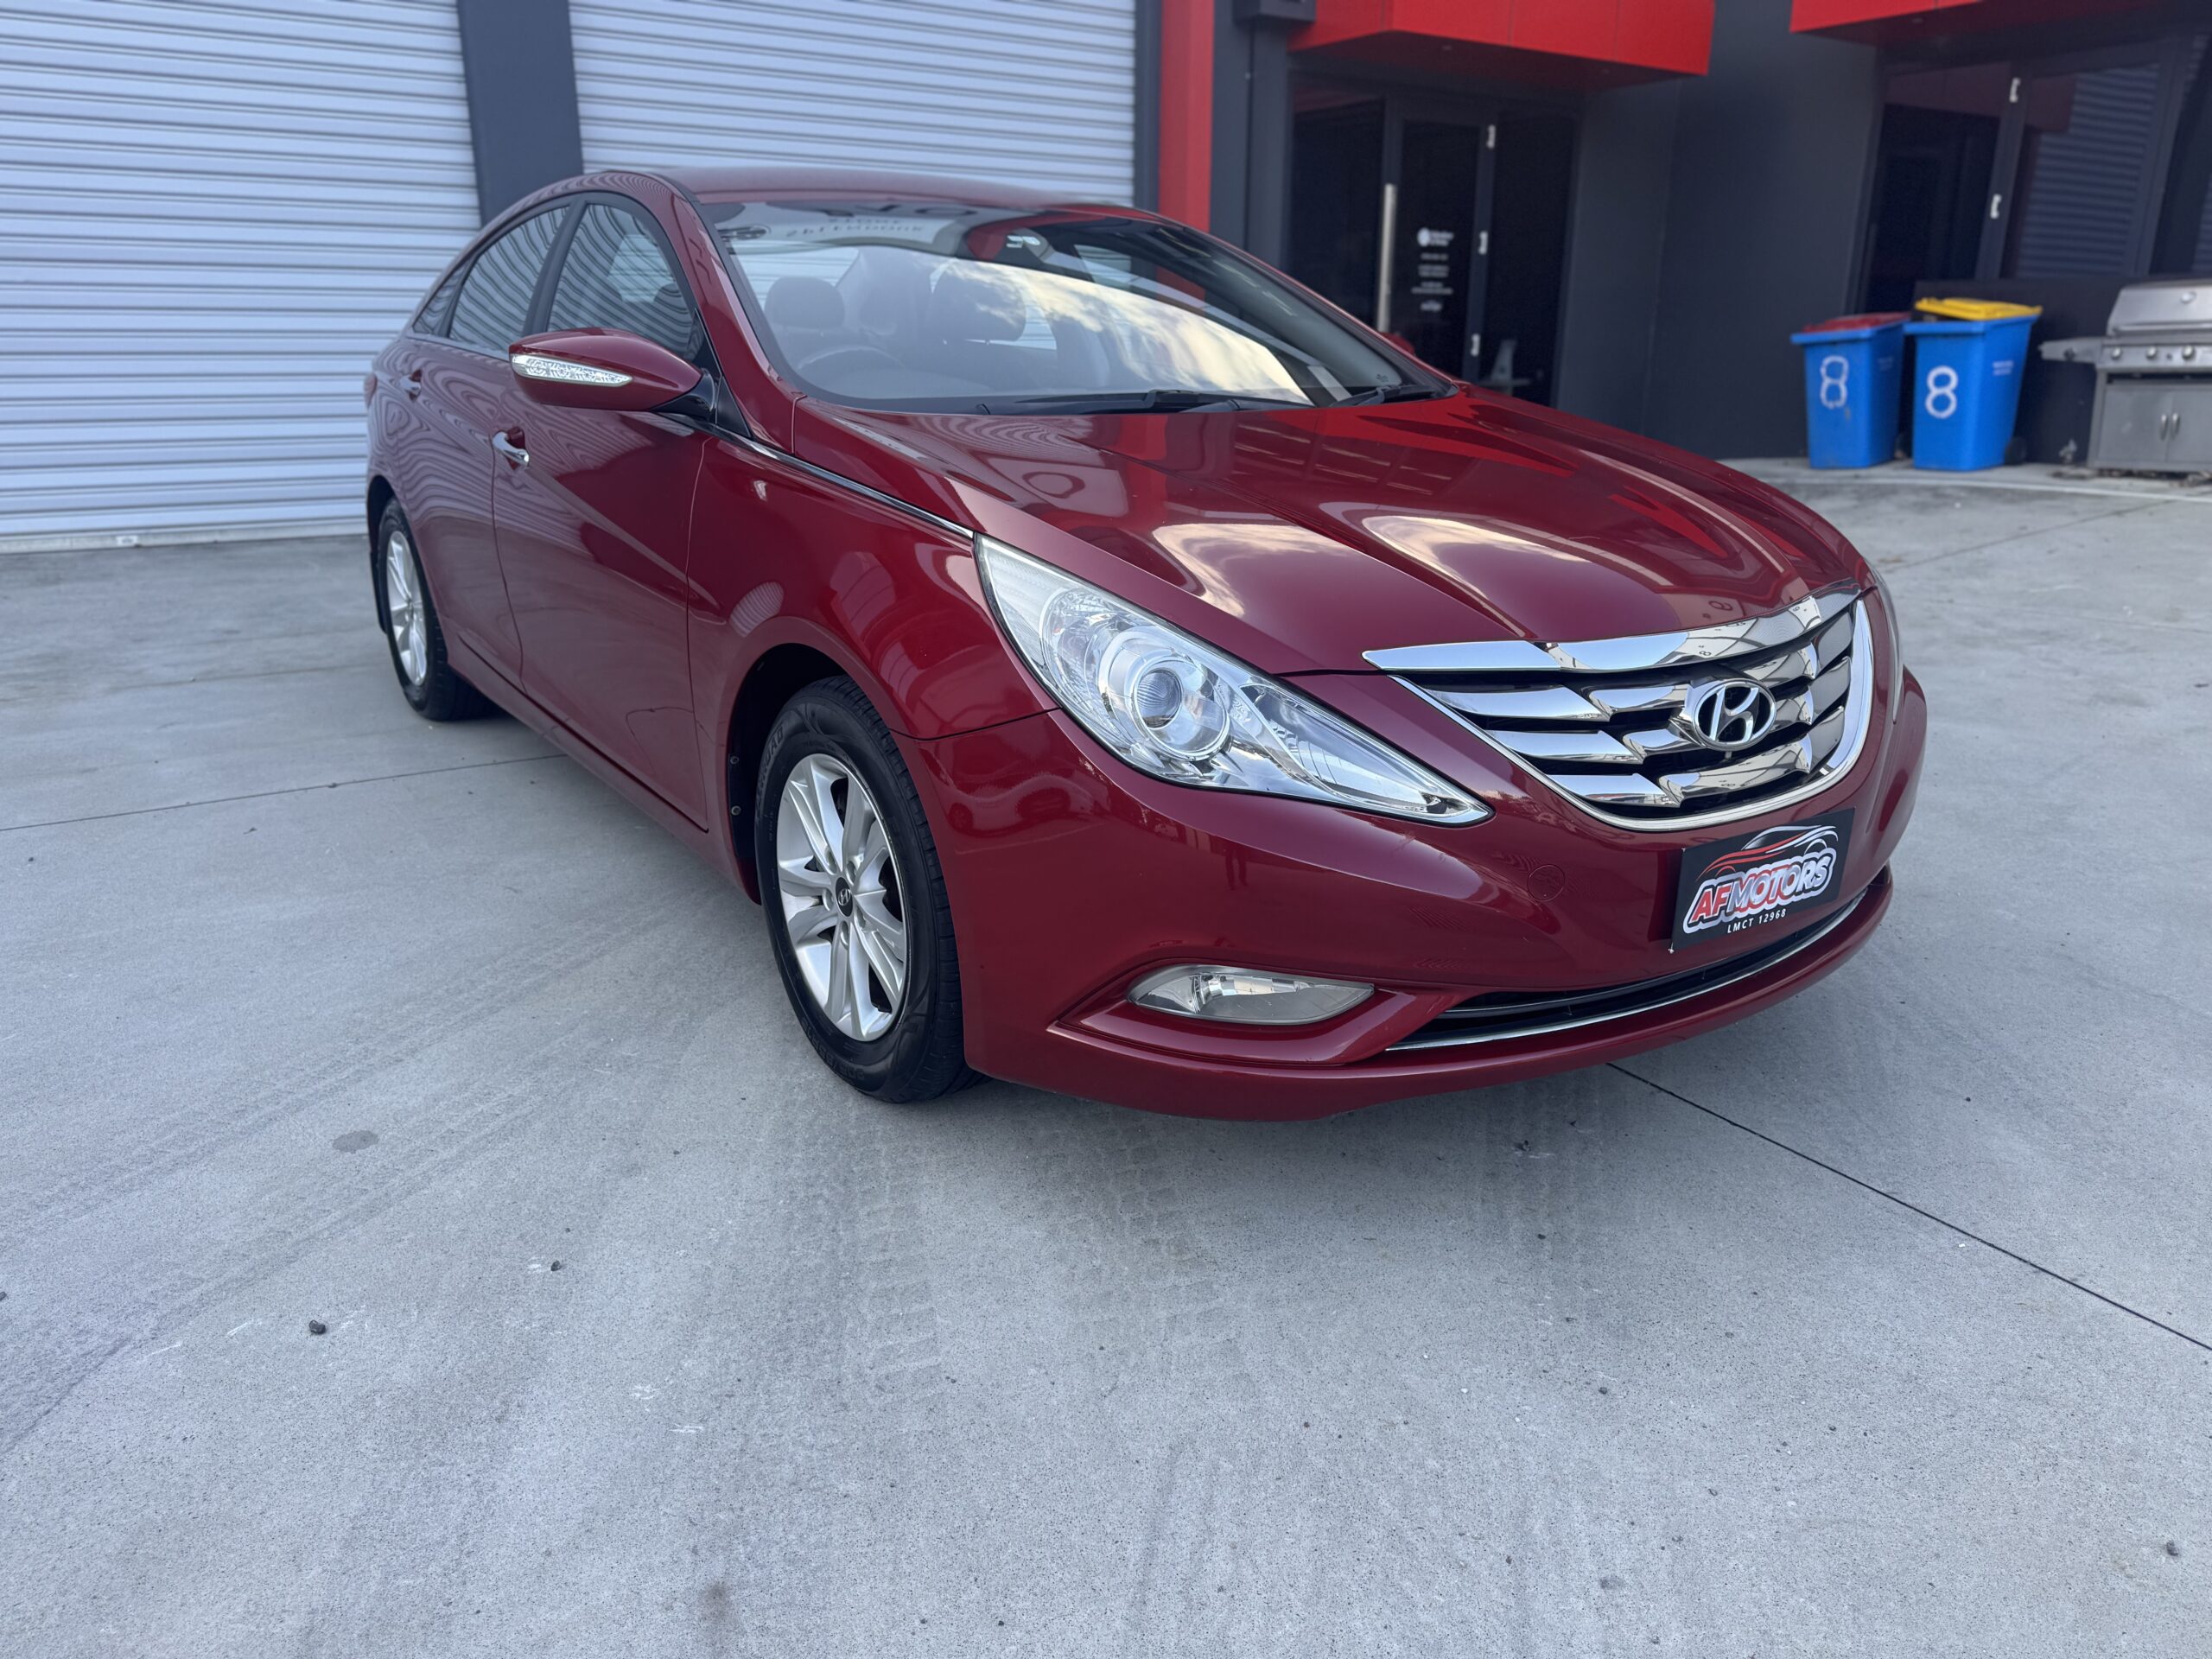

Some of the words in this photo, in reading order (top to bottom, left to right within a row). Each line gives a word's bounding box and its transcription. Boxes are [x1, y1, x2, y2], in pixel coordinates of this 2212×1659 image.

[1820, 355, 1849, 410] 8
[1924, 365, 1958, 419] 8
[1726, 918, 1753, 934] LMCT
[1758, 909, 1787, 925] 12968
